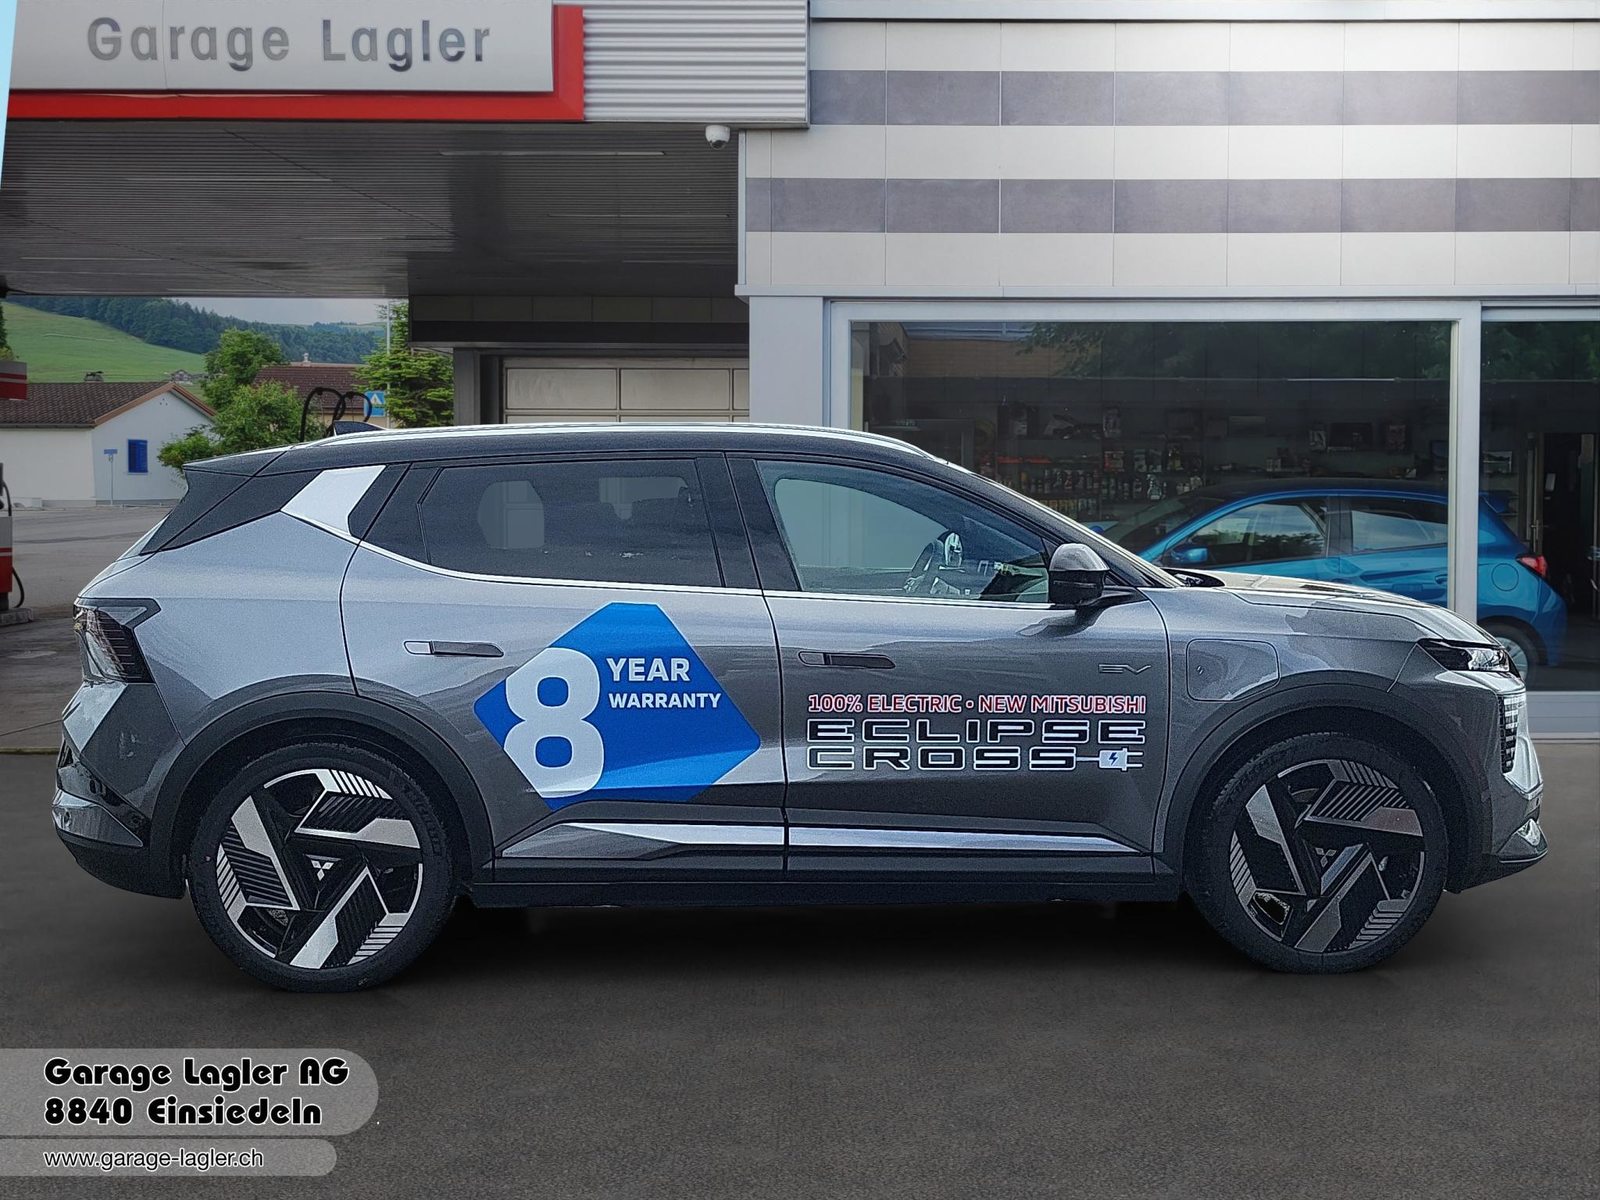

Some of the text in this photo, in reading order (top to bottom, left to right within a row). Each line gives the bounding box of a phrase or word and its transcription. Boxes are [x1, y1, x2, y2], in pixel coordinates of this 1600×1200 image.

[87, 16, 491, 73] Garage Lagler
[606, 657, 690, 682] YEAR
[608, 693, 721, 708] WARRANTY
[807, 694, 1146, 714] 100% ELECTRIC NEW MITSUBISHI
[503, 647, 604, 798] 8
[806, 718, 1146, 744] ECLIPSE
[806, 745, 1077, 771] CROSS
